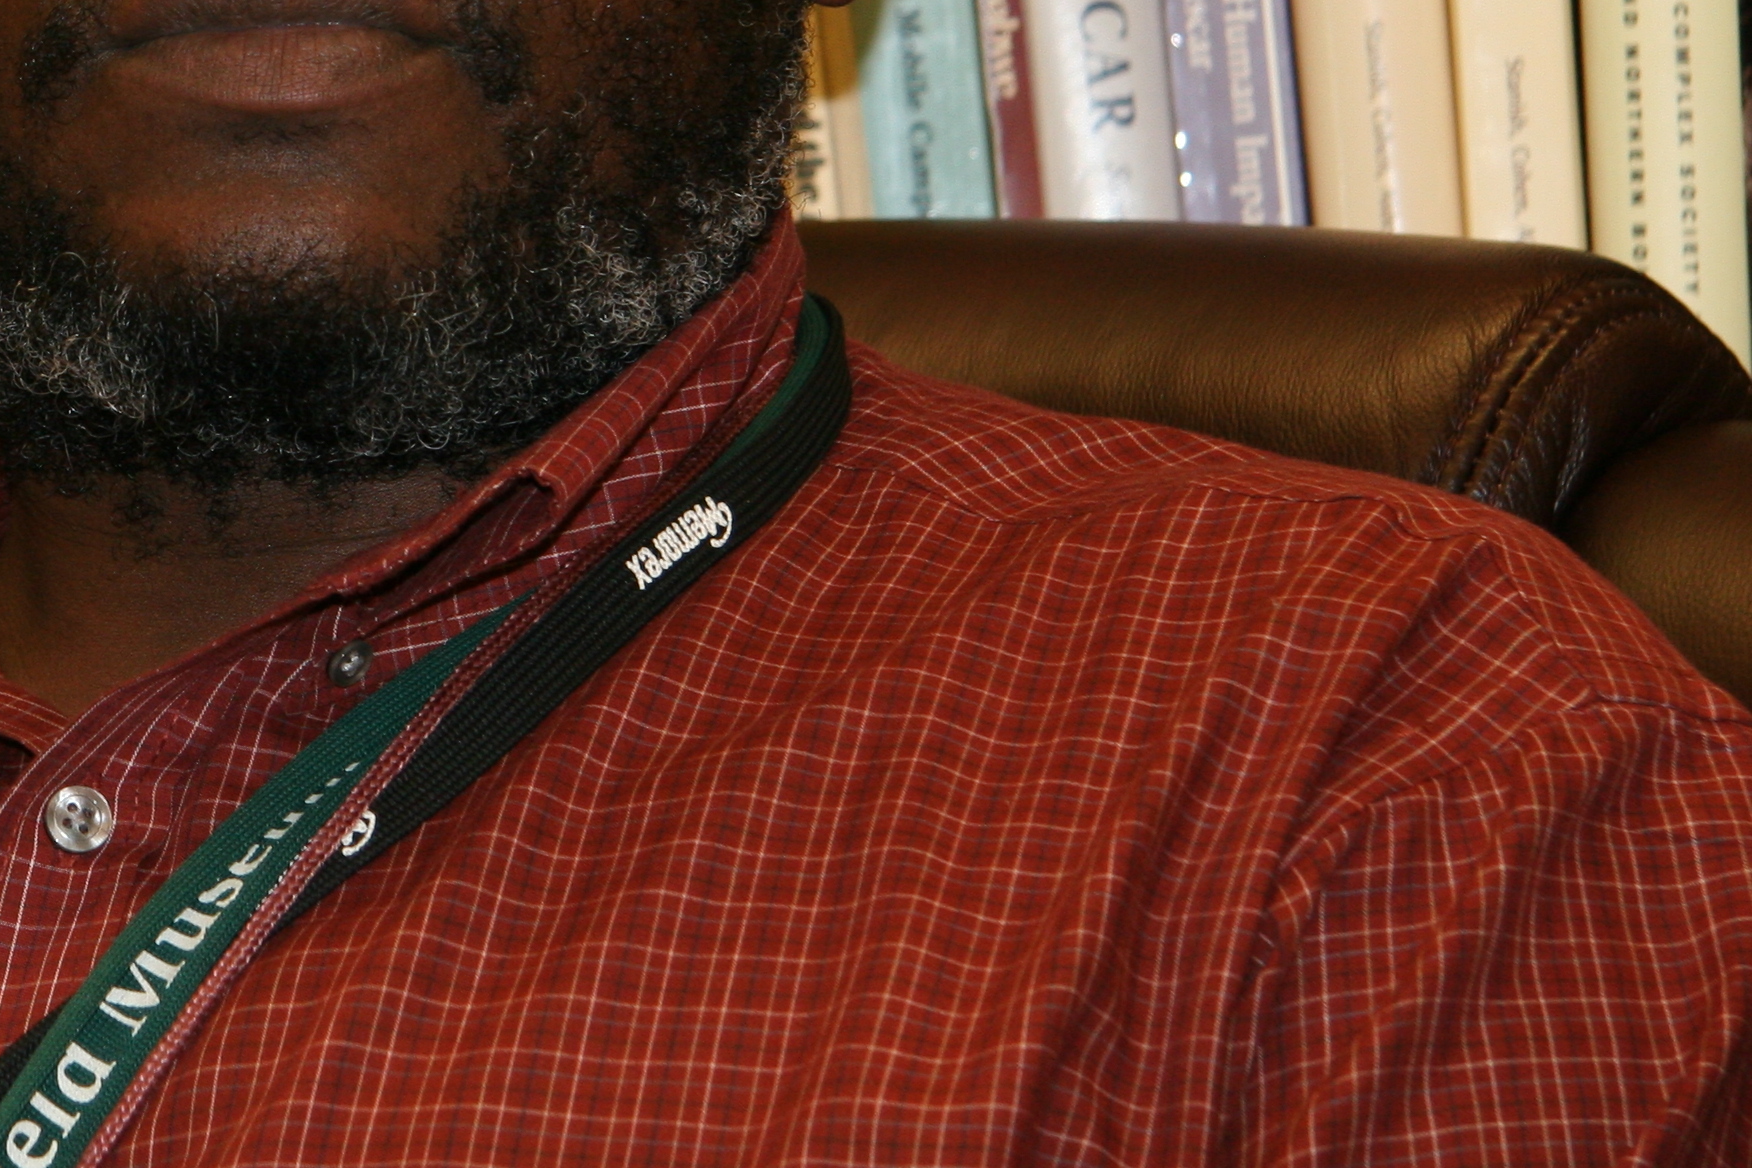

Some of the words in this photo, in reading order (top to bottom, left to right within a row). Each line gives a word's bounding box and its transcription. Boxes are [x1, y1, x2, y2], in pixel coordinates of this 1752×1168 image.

[896, 8, 930, 111] Mobile
[1672, 2, 1696, 147] COMPLEX
[908, 121, 937, 218] Camp
[1229, 135, 1268, 227] Impa
[1623, 43, 1646, 207] NORTHERN
[1677, 164, 1702, 297] SOCIETY
[625, 496, 733, 590] Memorex
[98, 761, 360, 1037] Museu
